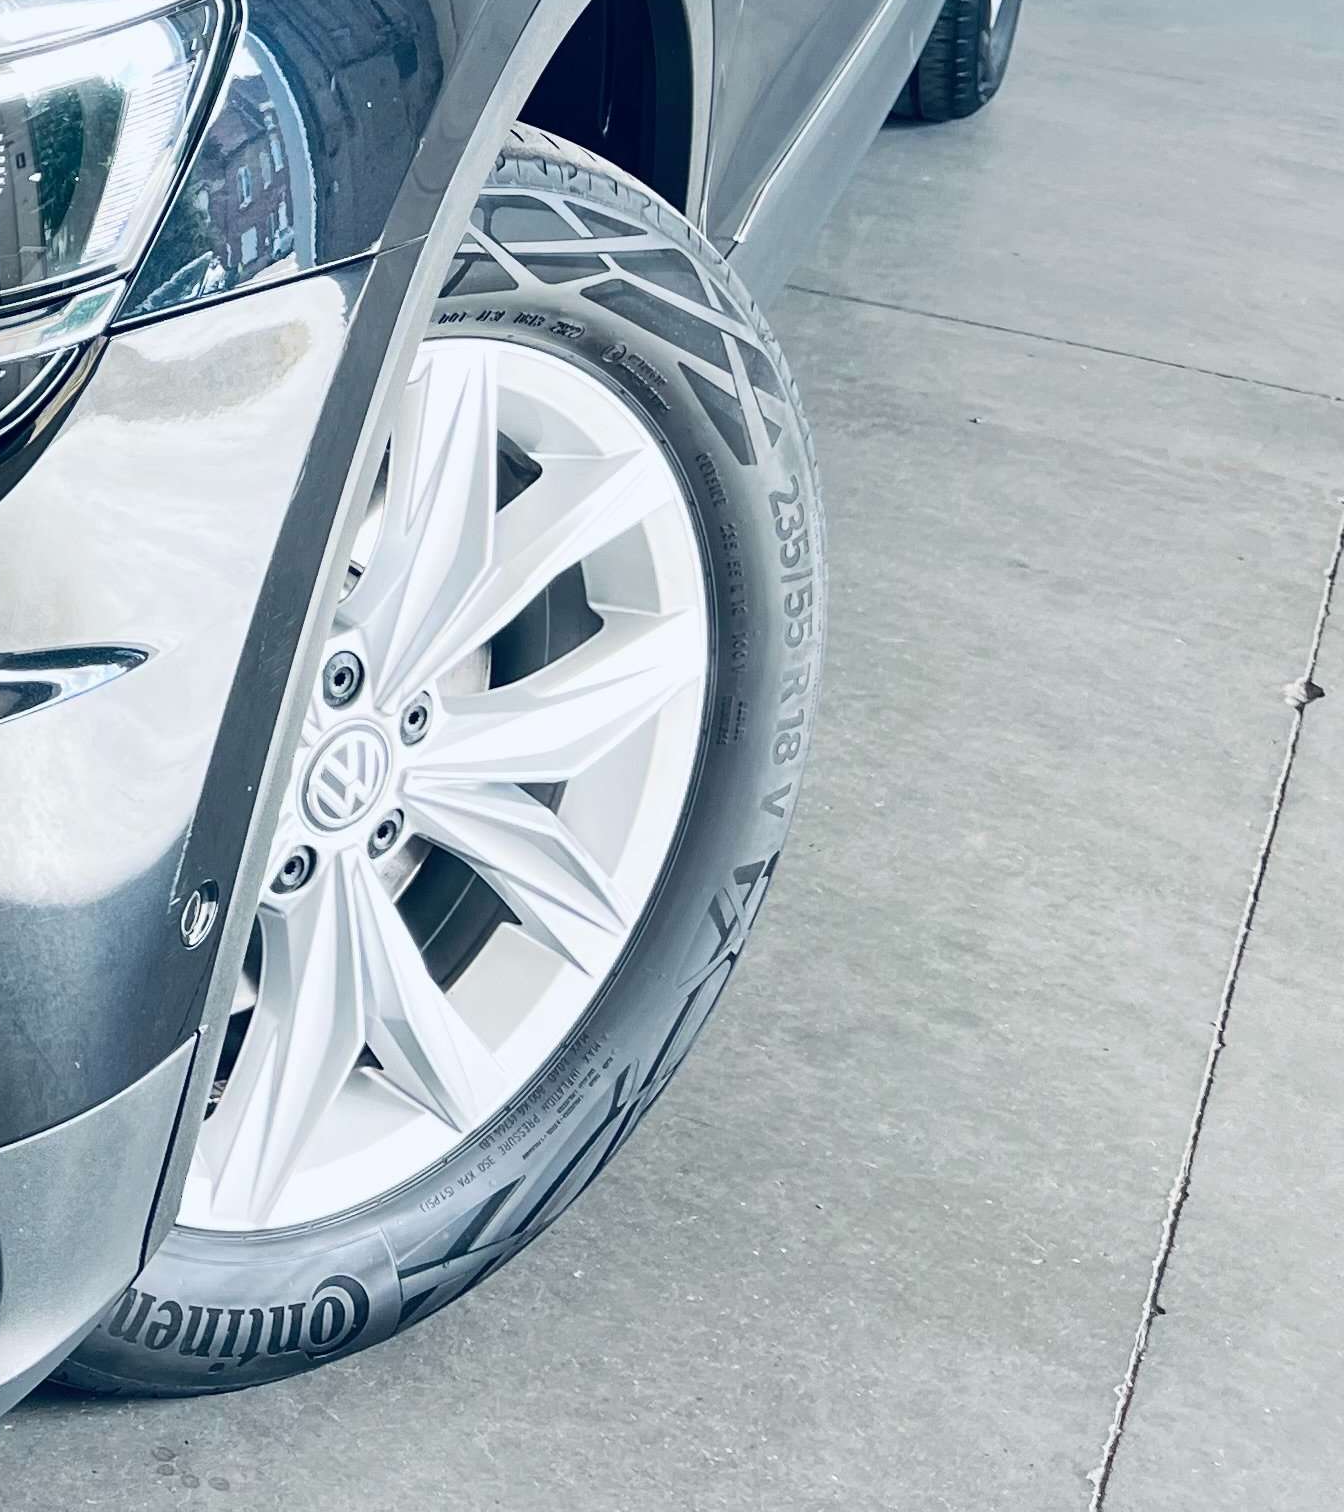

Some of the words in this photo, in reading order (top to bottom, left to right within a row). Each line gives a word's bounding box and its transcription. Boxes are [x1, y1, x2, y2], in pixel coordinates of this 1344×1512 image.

[768, 474, 813, 648] 235/55
[760, 782, 793, 819] V
[497, 1115, 541, 1156] PRESSURE
[105, 1274, 370, 1373] Continen
